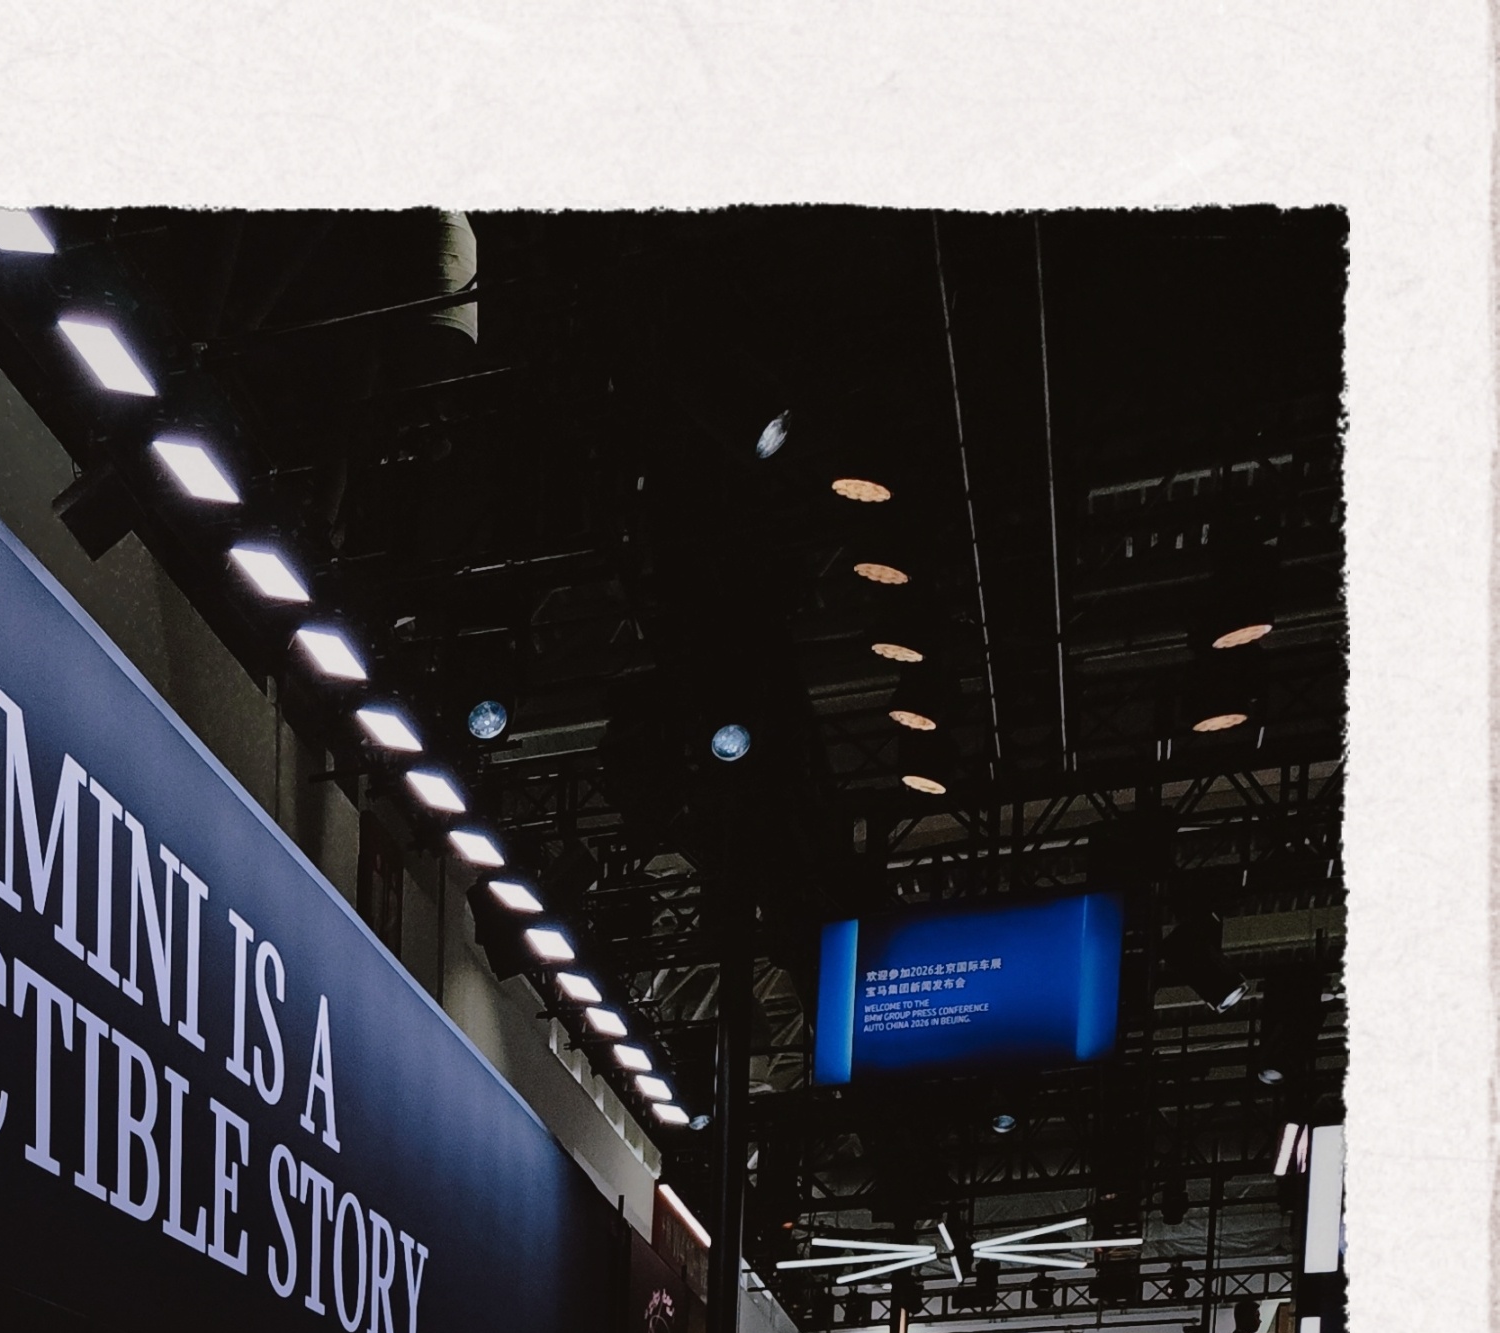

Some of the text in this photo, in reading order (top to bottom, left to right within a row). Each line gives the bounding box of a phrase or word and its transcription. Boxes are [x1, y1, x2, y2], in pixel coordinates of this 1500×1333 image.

[864, 999, 930, 1013] WELCOME TO THE
[864, 1003, 989, 1023] BMW GROUP PRESS CONFERENCE
[226, 909, 285, 1106] IS
[301, 994, 341, 1153] A
[863, 1022, 885, 1032] AUTO
[886, 1020, 909, 1030] CHINA
[910, 1019, 929, 1028] 2026
[930, 1017, 939, 1026] IN
